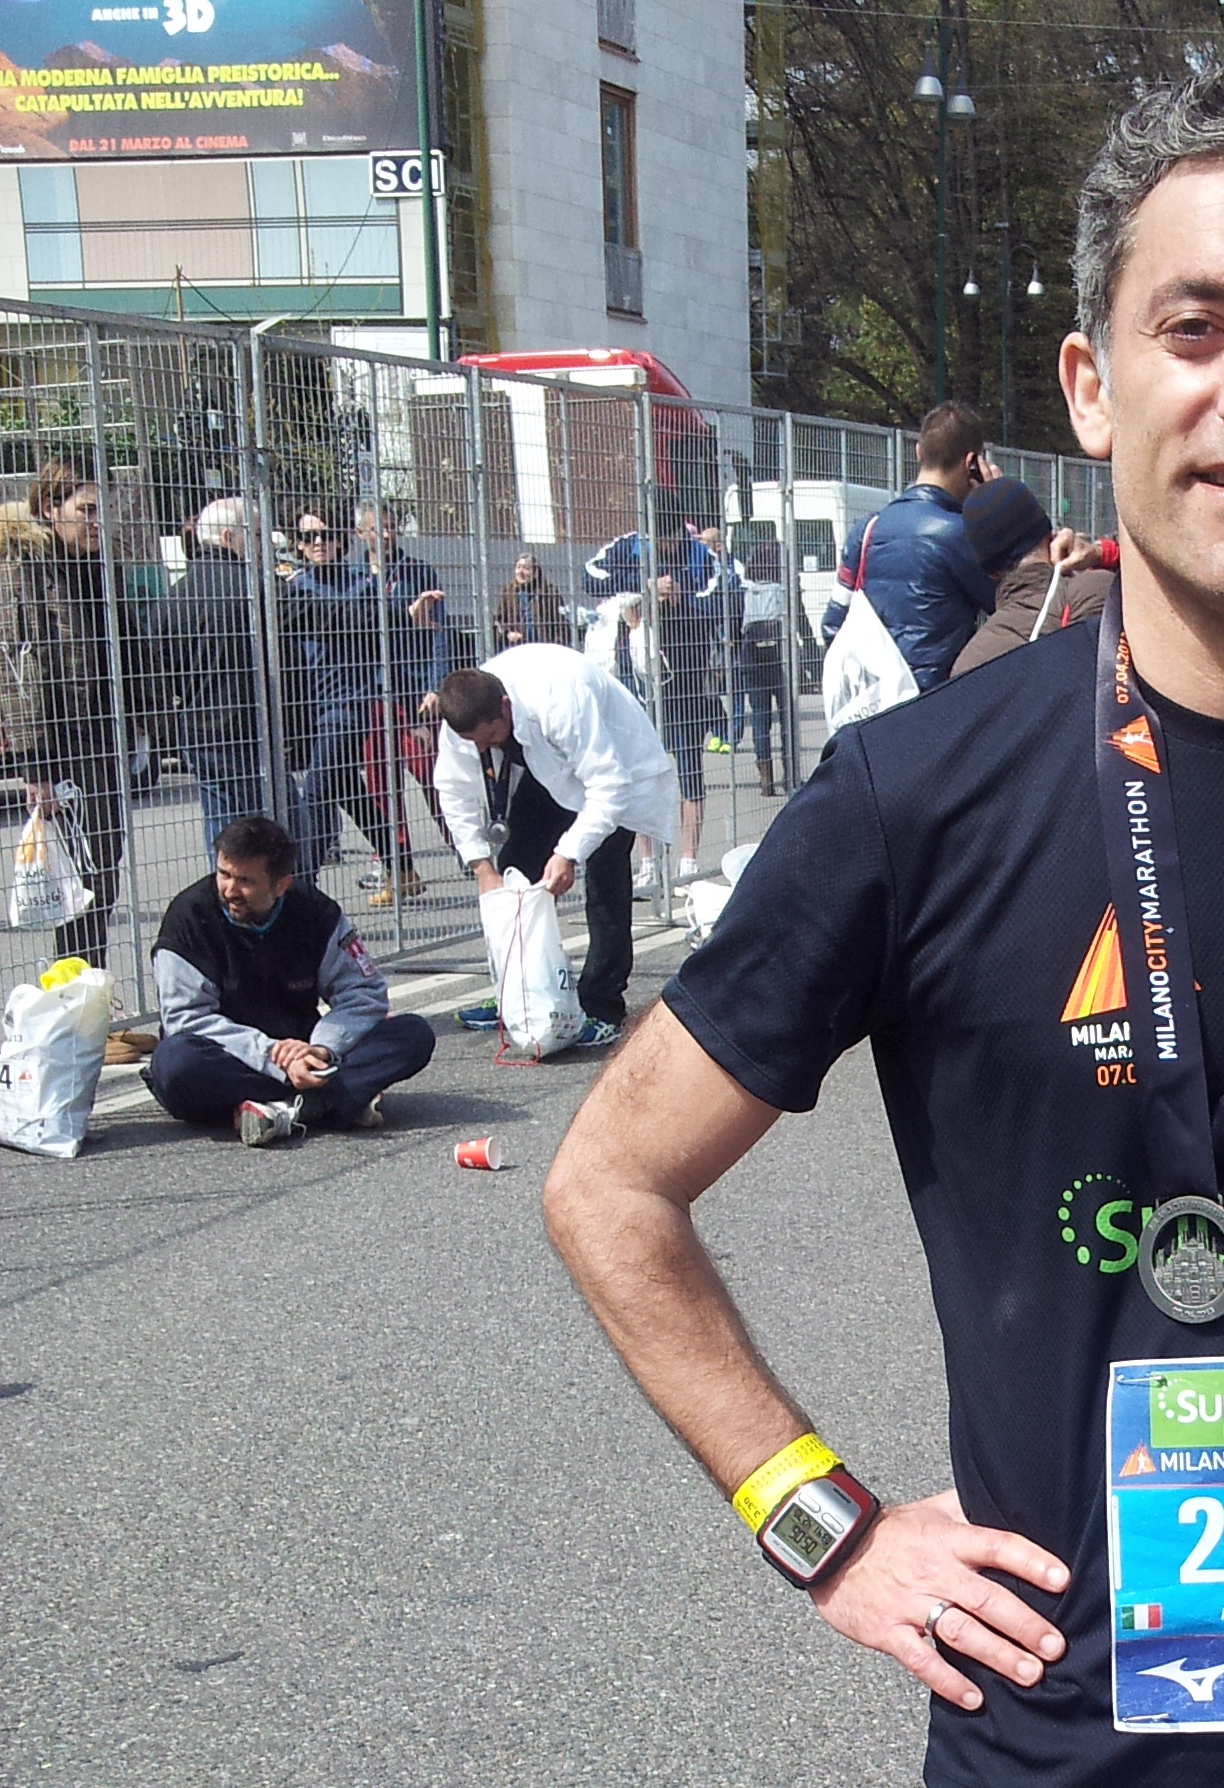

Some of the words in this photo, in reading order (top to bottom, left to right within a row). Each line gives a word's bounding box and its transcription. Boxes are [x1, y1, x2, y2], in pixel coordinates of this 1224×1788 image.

[91, 7, 140, 21] ANCHE
[141, 7, 159, 20] IN
[161, 0, 215, 36] 3D
[20, 67, 114, 88] MODERNA
[115, 65, 205, 87] FAMIGLIA
[207, 62, 340, 84] PREISTORICA...
[14, 92, 139, 112] CATAPULTATA
[140, 88, 304, 110] NELL'AVVENTURA!
[68, 138, 97, 152] DAL
[99, 137, 117, 151] 21
[121, 136, 172, 151] MARZO
[174, 135, 193, 150] AL
[195, 134, 249, 150] CINEMA
